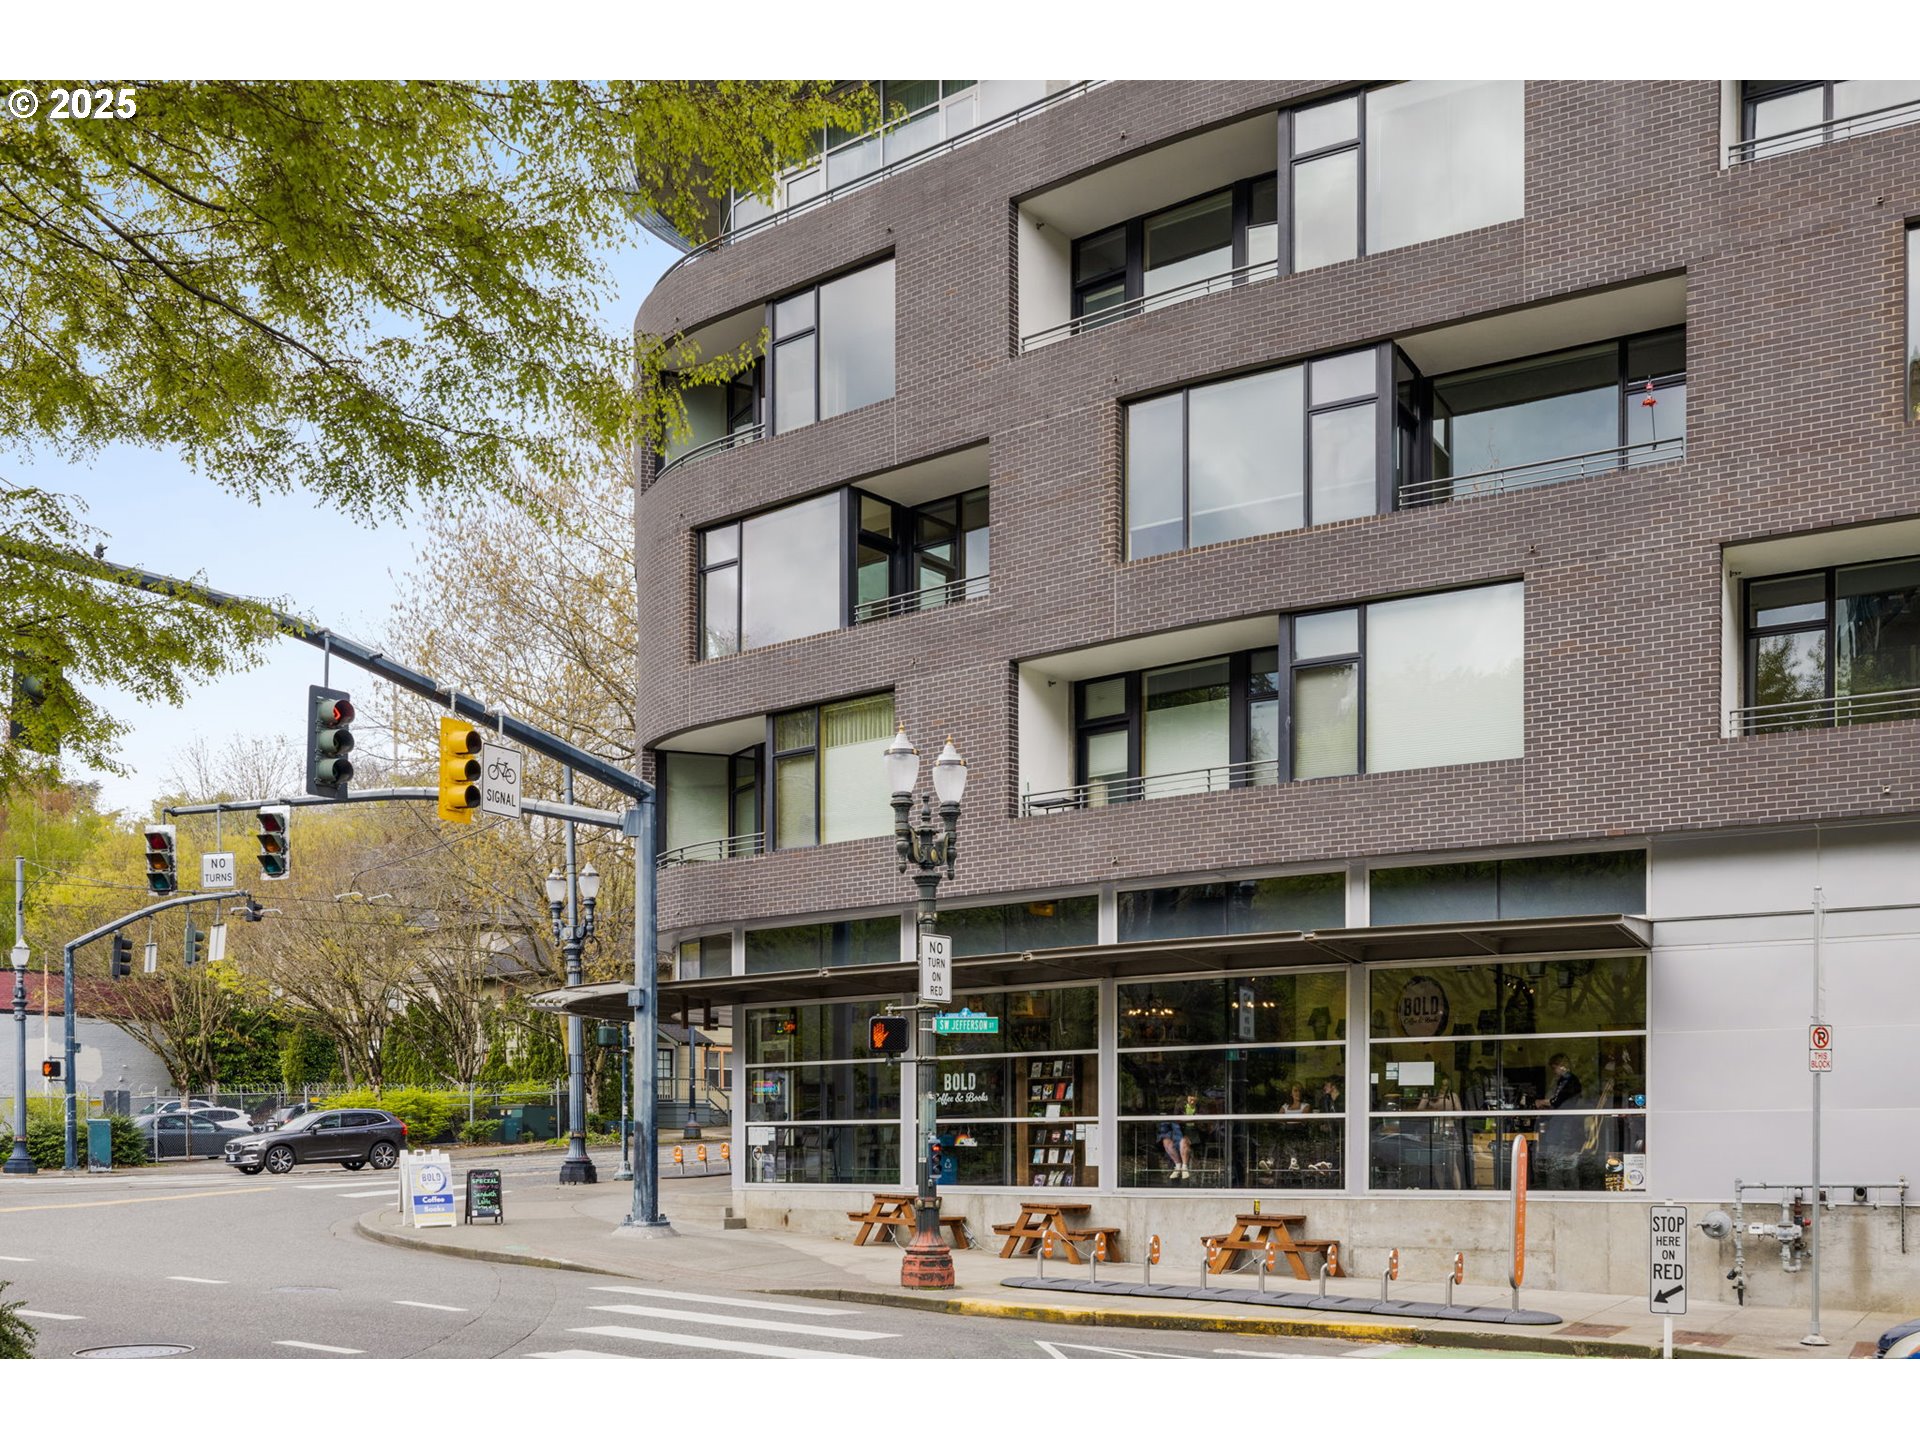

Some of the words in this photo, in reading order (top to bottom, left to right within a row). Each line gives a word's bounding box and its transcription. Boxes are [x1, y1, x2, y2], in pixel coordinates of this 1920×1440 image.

[486, 788, 516, 807] SIGNAL
[211, 858, 226, 868] NO
[205, 872, 232, 882] TURNS
[929, 942, 943, 954] NO
[928, 957, 946, 968] TURN
[931, 971, 942, 982] ON
[930, 985, 943, 997] RED
[1403, 995, 1439, 1016] BOLD
[939, 1019, 950, 1030] SW
[951, 1019, 988, 1030] JEFFERSON
[1813, 1052, 1828, 1060] THIS
[1811, 1060, 1831, 1068] BLOCK
[943, 1072, 976, 1091] BOLD
[955, 1092, 964, 1102] &
[965, 1091, 989, 1103] Books
[421, 1173, 441, 1182] BOLD
[422, 1196, 446, 1204] Coffee
[1652, 1216, 1685, 1233] STOP
[1655, 1236, 1681, 1247] HERE
[1661, 1249, 1675, 1260] ON
[1653, 1263, 1684, 1280] RED
